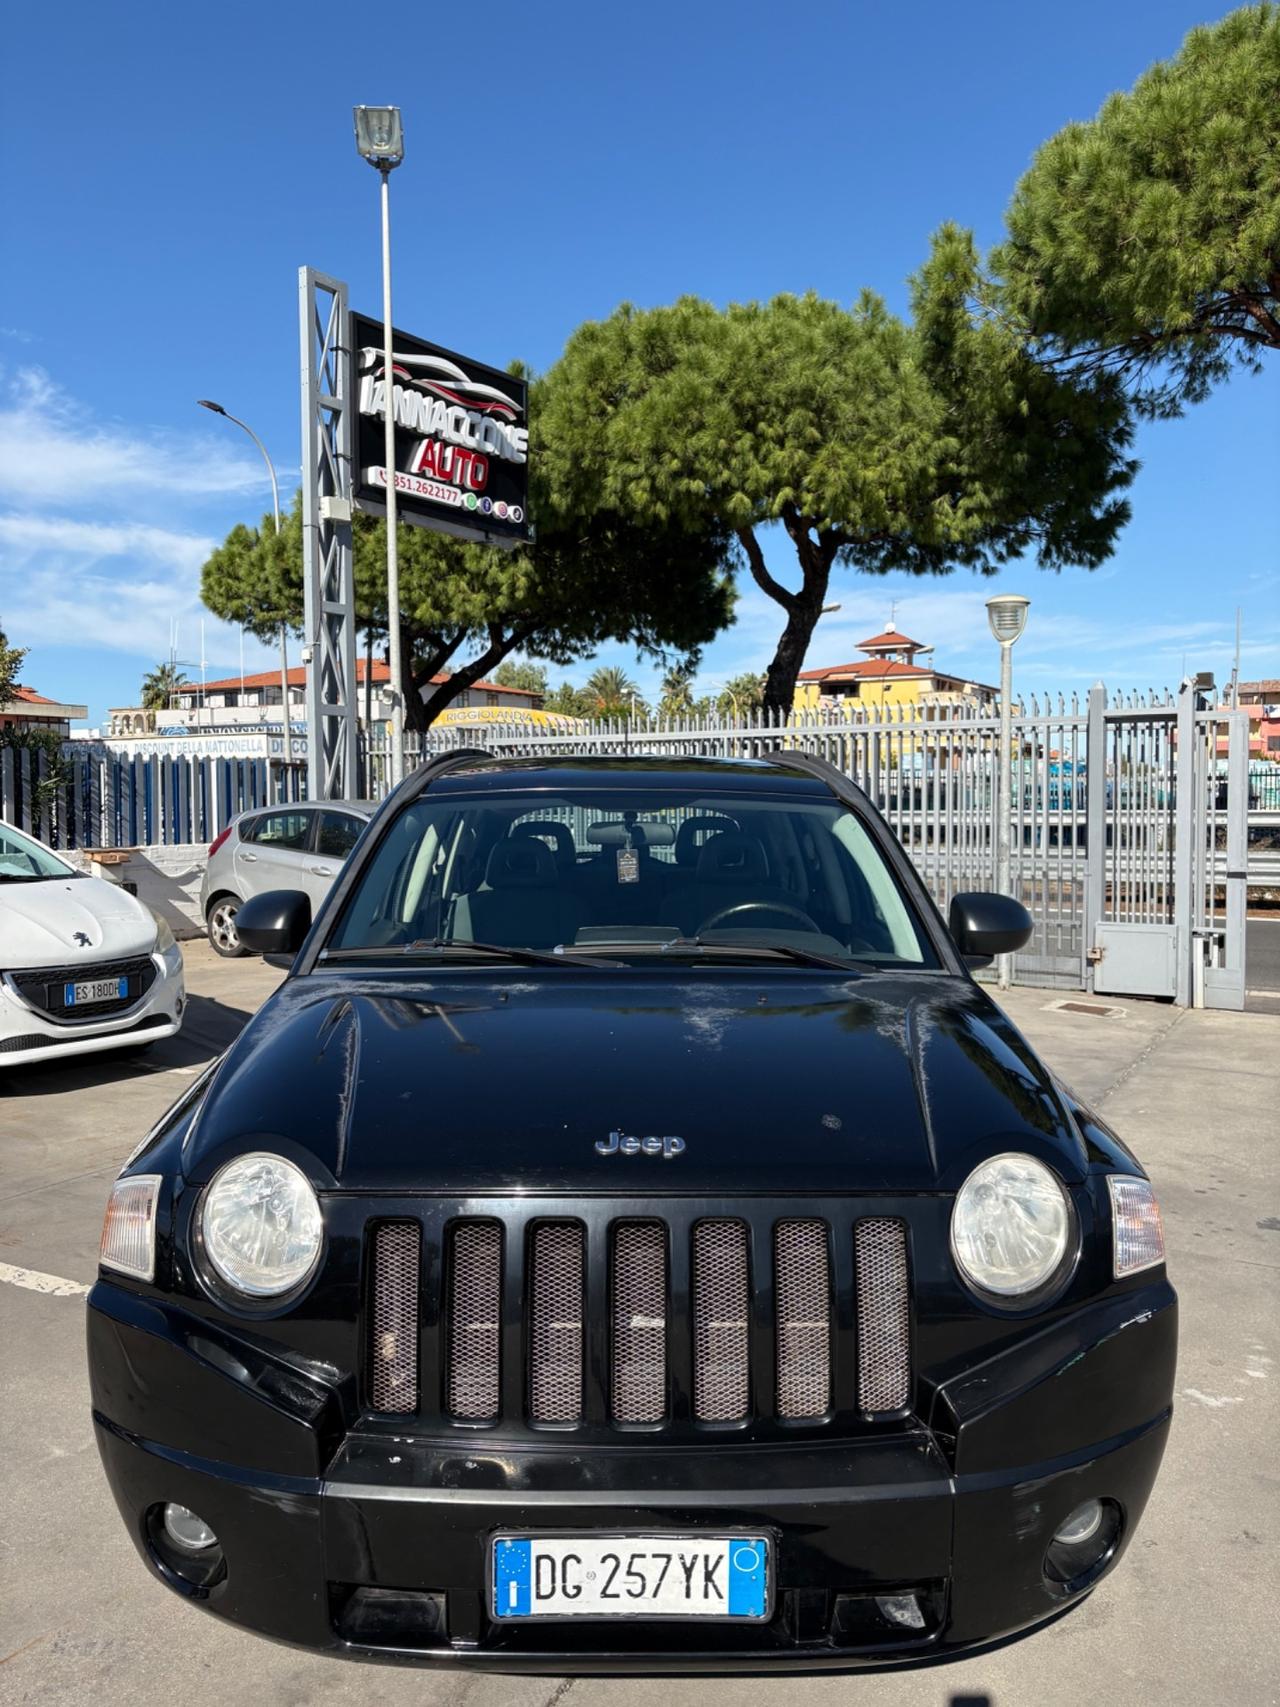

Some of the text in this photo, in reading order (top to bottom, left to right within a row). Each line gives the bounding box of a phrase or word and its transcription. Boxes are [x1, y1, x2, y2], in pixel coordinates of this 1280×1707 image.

[360, 375, 528, 463] IANNACCONE
[411, 438, 489, 490] AUTO
[134, 742, 174, 754] DISCOUNT
[177, 741, 203, 753] DELLA
[205, 739, 263, 753] MATTONELLA
[76, 986, 88, 1000] ES
[595, 1132, 686, 1158] Jeep
[535, 1554, 583, 1600] DG
[600, 1553, 725, 1600] 257YK
